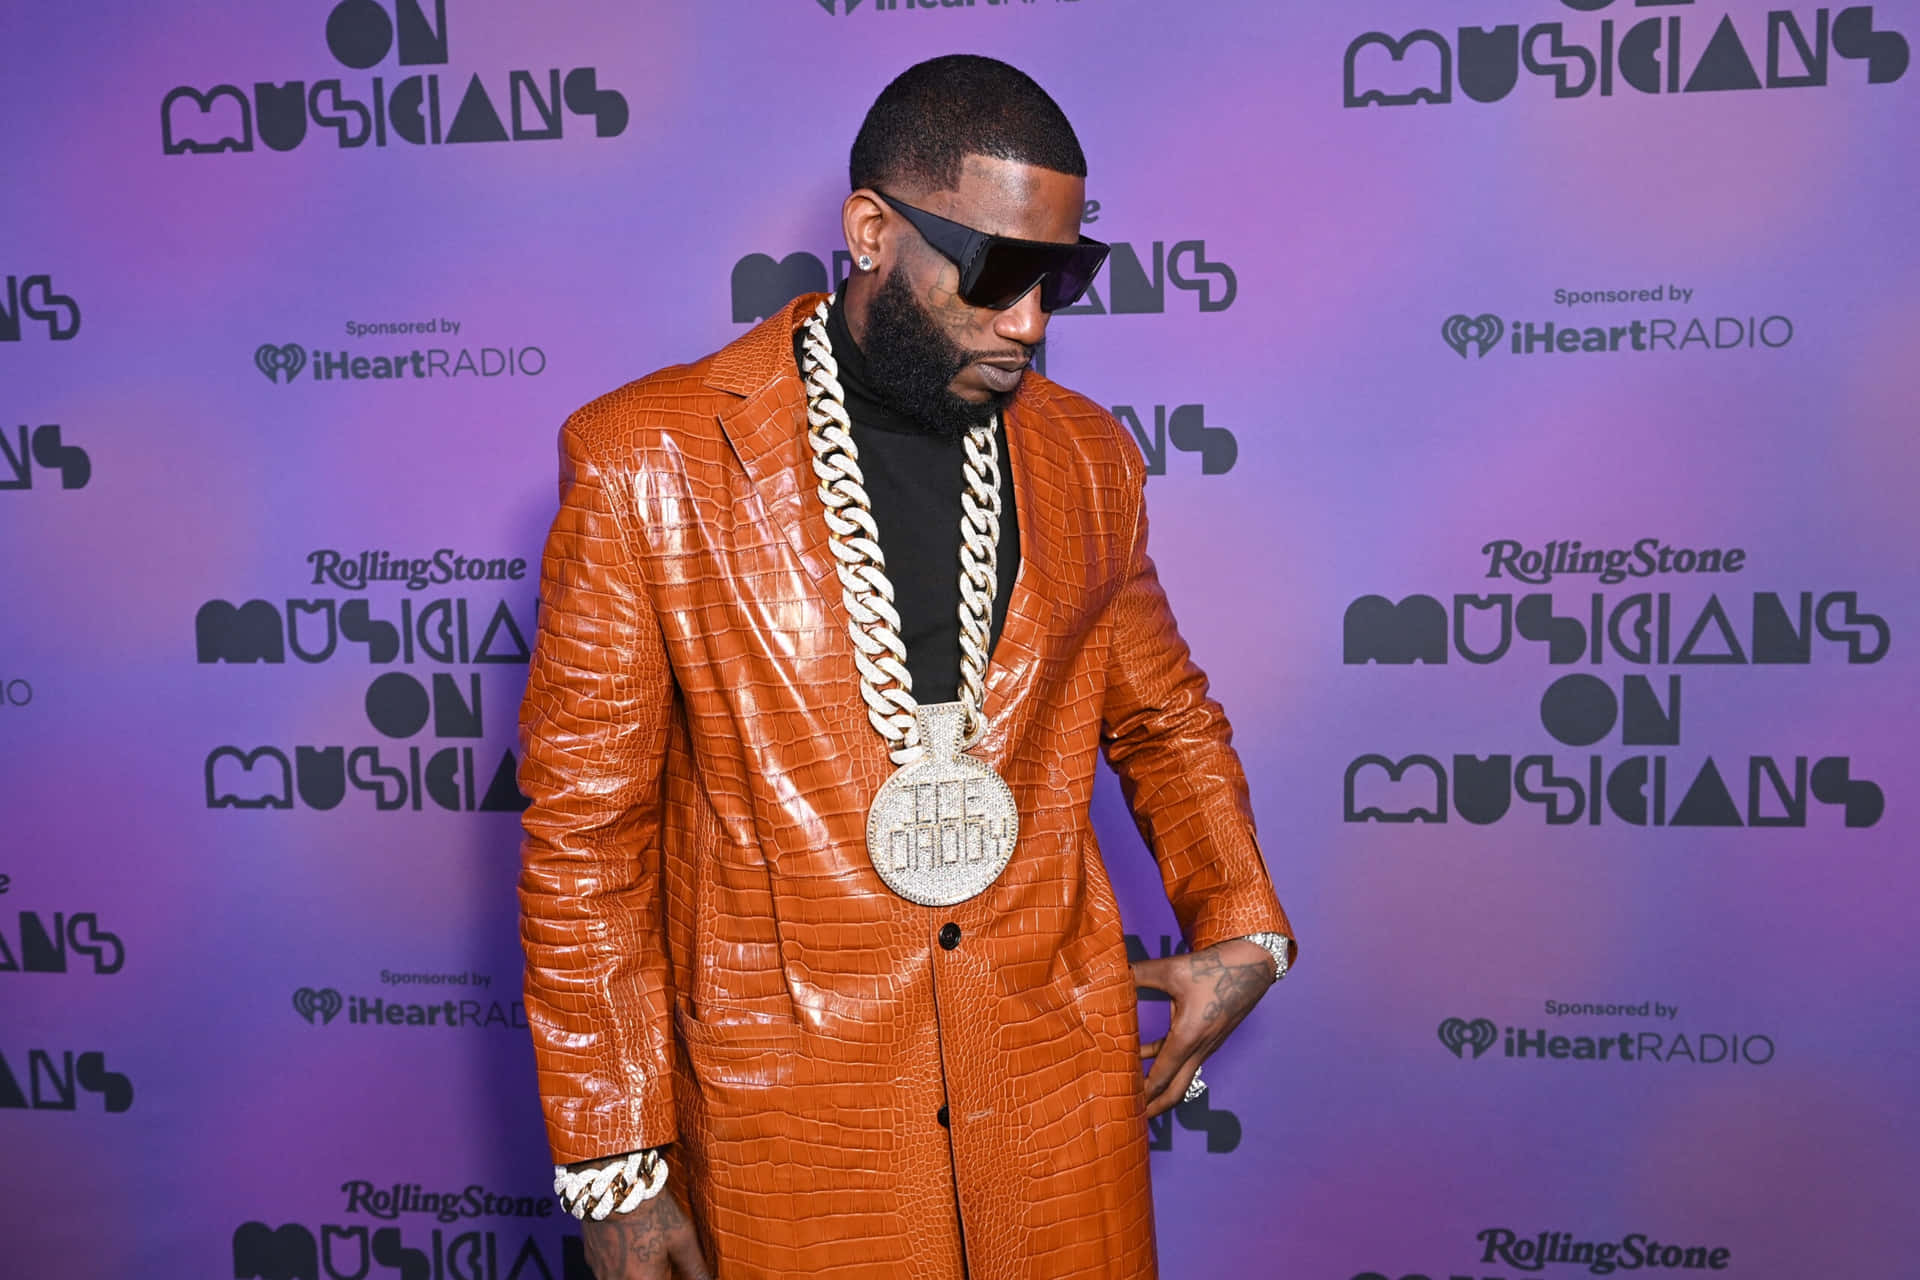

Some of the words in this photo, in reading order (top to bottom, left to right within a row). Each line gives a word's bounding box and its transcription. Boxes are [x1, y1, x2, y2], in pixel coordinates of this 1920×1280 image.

[326, 0, 449, 70] ON
[1343, 6, 1911, 108] MUSICIANS
[161, 67, 630, 156] MUSICIANS
[345, 319, 437, 338] Sponsored
[440, 318, 461, 335] by
[1554, 286, 1664, 307] Sponsored
[1668, 284, 1694, 304] by
[312, 346, 547, 380] iHeartRADIO
[1511, 315, 1794, 355] iHeartRADIO
[195, 598, 541, 665] MUSICIA
[1343, 591, 1892, 665] MUSICIANS
[365, 671, 484, 739] ON
[1540, 673, 1682, 747] ON
[204, 745, 534, 812] MUSICIA
[1343, 754, 1886, 828] MUSICIANS
[349, 995, 528, 1029] iHeartRAD
[380, 969, 467, 986] Sponsored
[472, 971, 491, 988] by
[1544, 1000, 1650, 1017] Sponsored
[1655, 1001, 1679, 1020] by
[1504, 1027, 1776, 1066] iHeartRADIO
